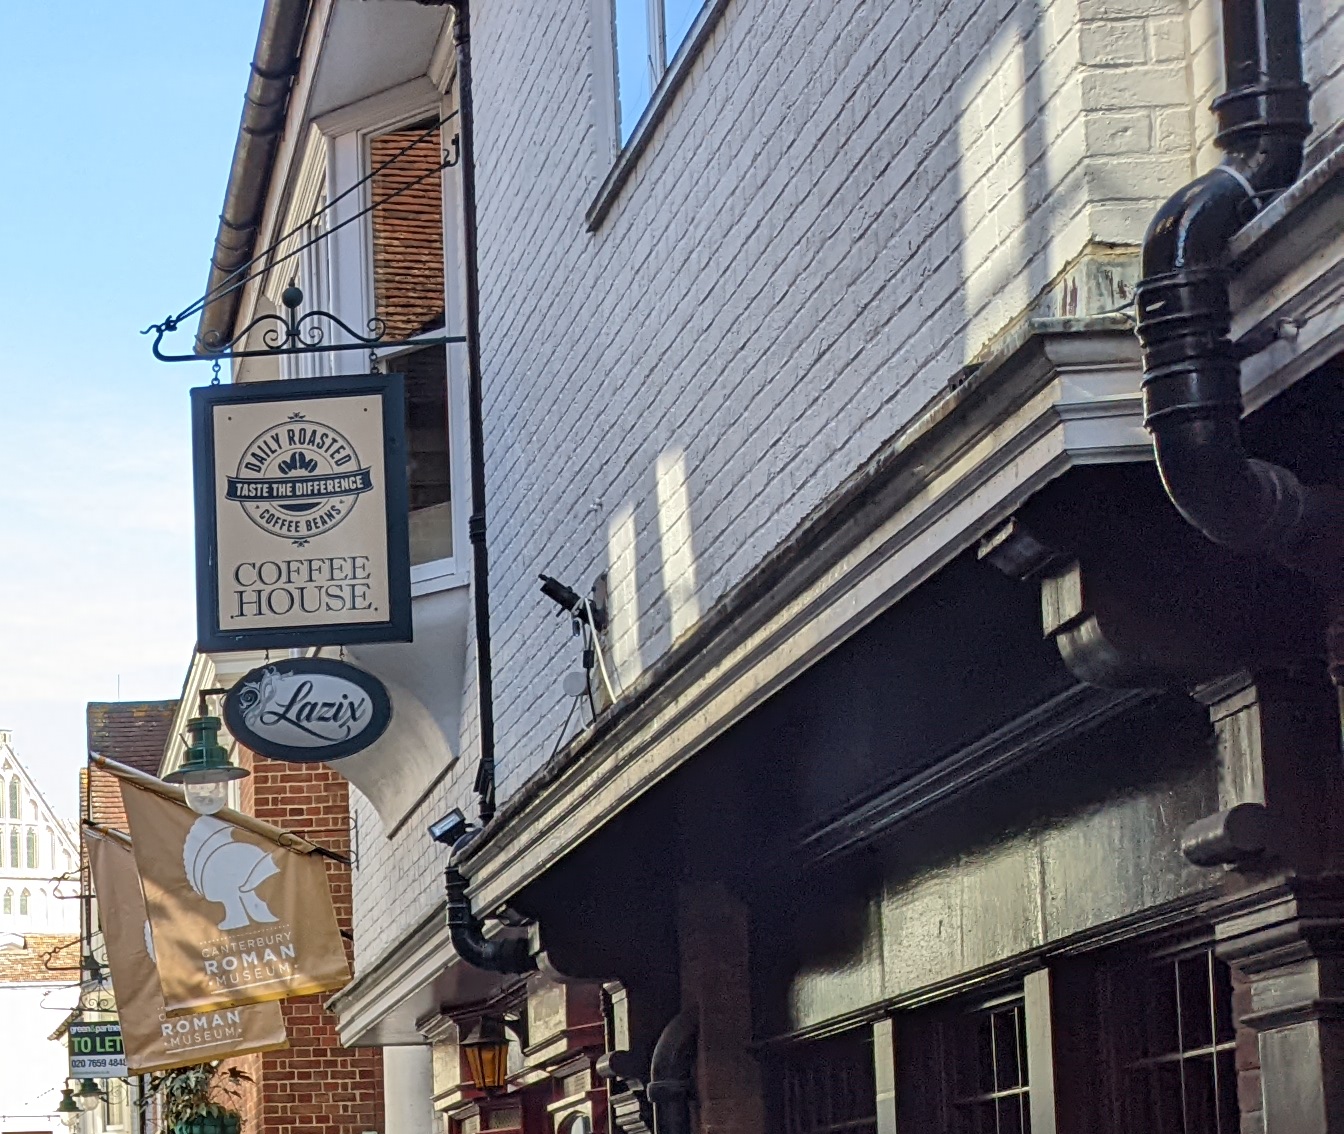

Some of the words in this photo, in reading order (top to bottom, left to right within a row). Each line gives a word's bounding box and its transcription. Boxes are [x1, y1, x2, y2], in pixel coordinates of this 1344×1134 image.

[244, 433, 283, 474] DAILY
[287, 427, 353, 467] ROASTED
[236, 483, 269, 497] TASTE
[272, 482, 293, 496] THE
[295, 475, 363, 495] DIFFERENCE
[259, 508, 301, 533] COFFEE
[305, 504, 342, 532] BEANS
[233, 555, 372, 587] COFFEE
[233, 583, 373, 618] HOUSE
[202, 931, 292, 958] CANTERBURY
[204, 943, 295, 975] ROMAN
[216, 962, 290, 986] MUSEUM
[161, 1011, 240, 1036] ROMAN
[71, 1036, 92, 1053] TO
[96, 1036, 123, 1052] LET
[170, 1027, 235, 1047] MUSEUM
[72, 1059, 86, 1068] 020
